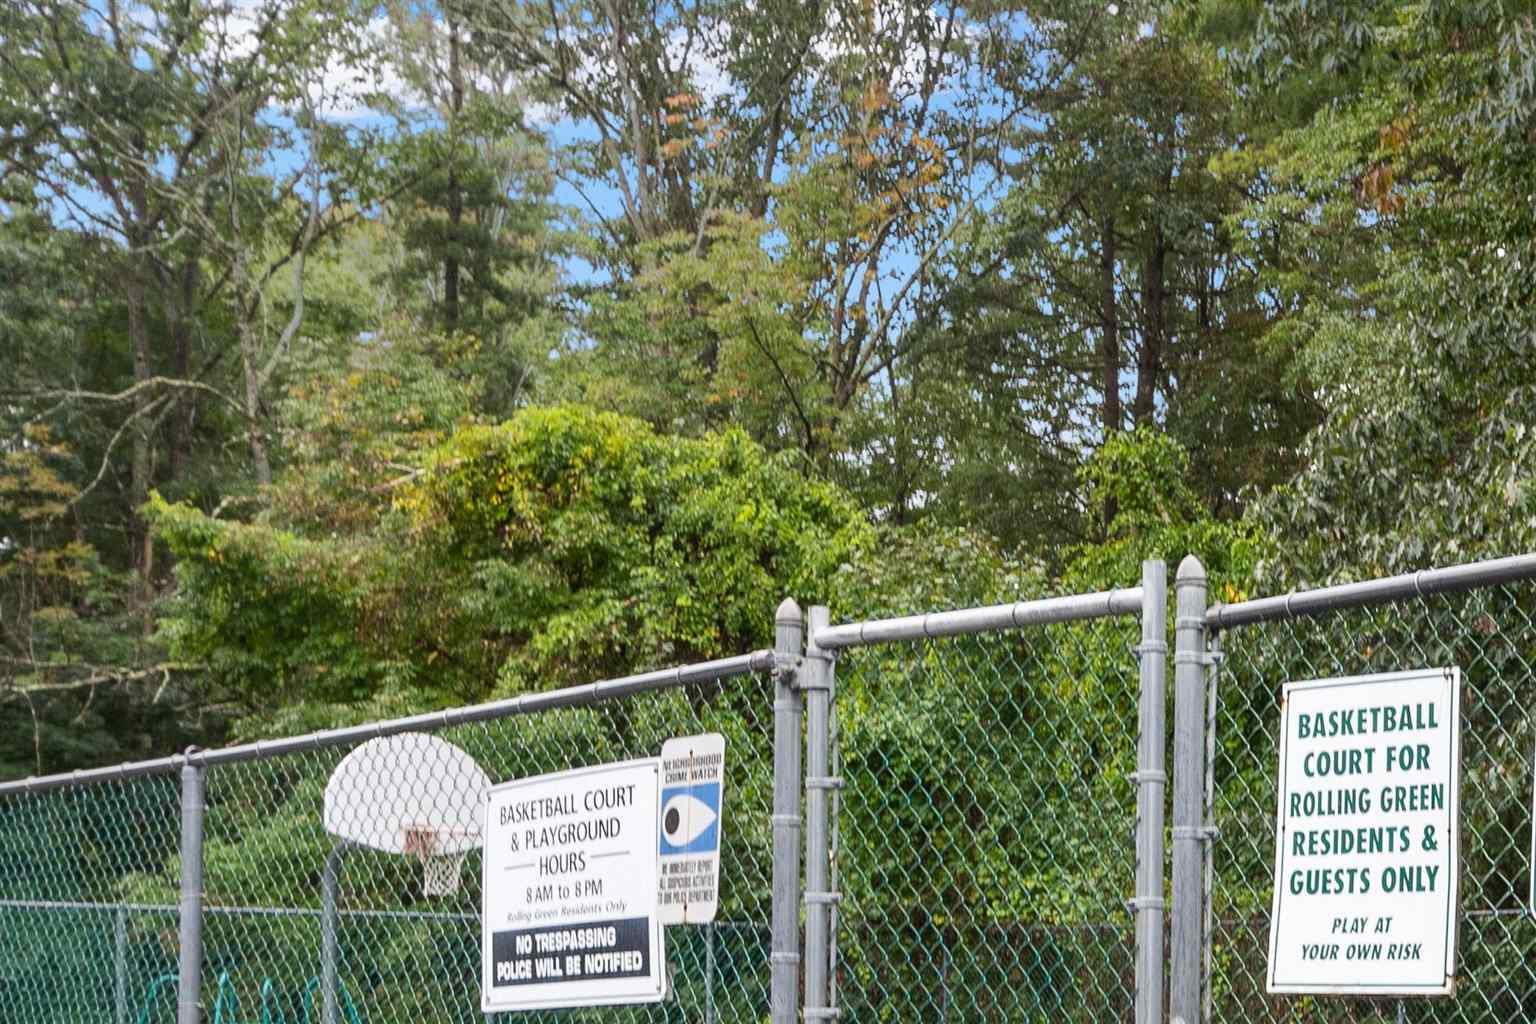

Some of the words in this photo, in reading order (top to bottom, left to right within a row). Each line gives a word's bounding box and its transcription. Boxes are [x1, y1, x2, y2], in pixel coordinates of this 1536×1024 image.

[1298, 702, 1438, 739] BASKETBALL
[691, 767, 718, 780] WATCH
[1303, 747, 1375, 777] COURT
[1386, 744, 1430, 772] FOR
[500, 793, 578, 826] BASKETBALL
[584, 784, 636, 811] COURT
[1290, 787, 1371, 817] ROLLING
[1380, 783, 1444, 812] GREEN
[511, 832, 519, 852] &
[525, 816, 621, 850] PLAYGROUND
[1292, 826, 1410, 856] RESIDENTS
[1421, 824, 1438, 851] &
[539, 850, 586, 877] HOURS
[526, 887, 532, 903] 8
[535, 884, 553, 902] AM
[558, 884, 570, 899] to
[575, 880, 582, 897] 8
[585, 878, 603, 896] PM
[1290, 868, 1370, 895] GUESTS
[1381, 865, 1439, 893] ONLY
[507, 911, 532, 923] Rolling
[534, 909, 558, 920] Green
[561, 902, 602, 916] Residents
[606, 899, 628, 913] Only
[1332, 916, 1368, 934] PLAY
[1374, 916, 1393, 934] AT
[516, 934, 532, 954] NO
[535, 926, 616, 953] TRESPASSING
[1302, 943, 1339, 960] YOUR
[1346, 943, 1382, 960] OWN
[1387, 943, 1422, 960] RISK
[497, 959, 532, 982] POLICE
[535, 956, 563, 979] WILL
[566, 954, 581, 976] BE
[585, 950, 643, 974] NOTIFIED
